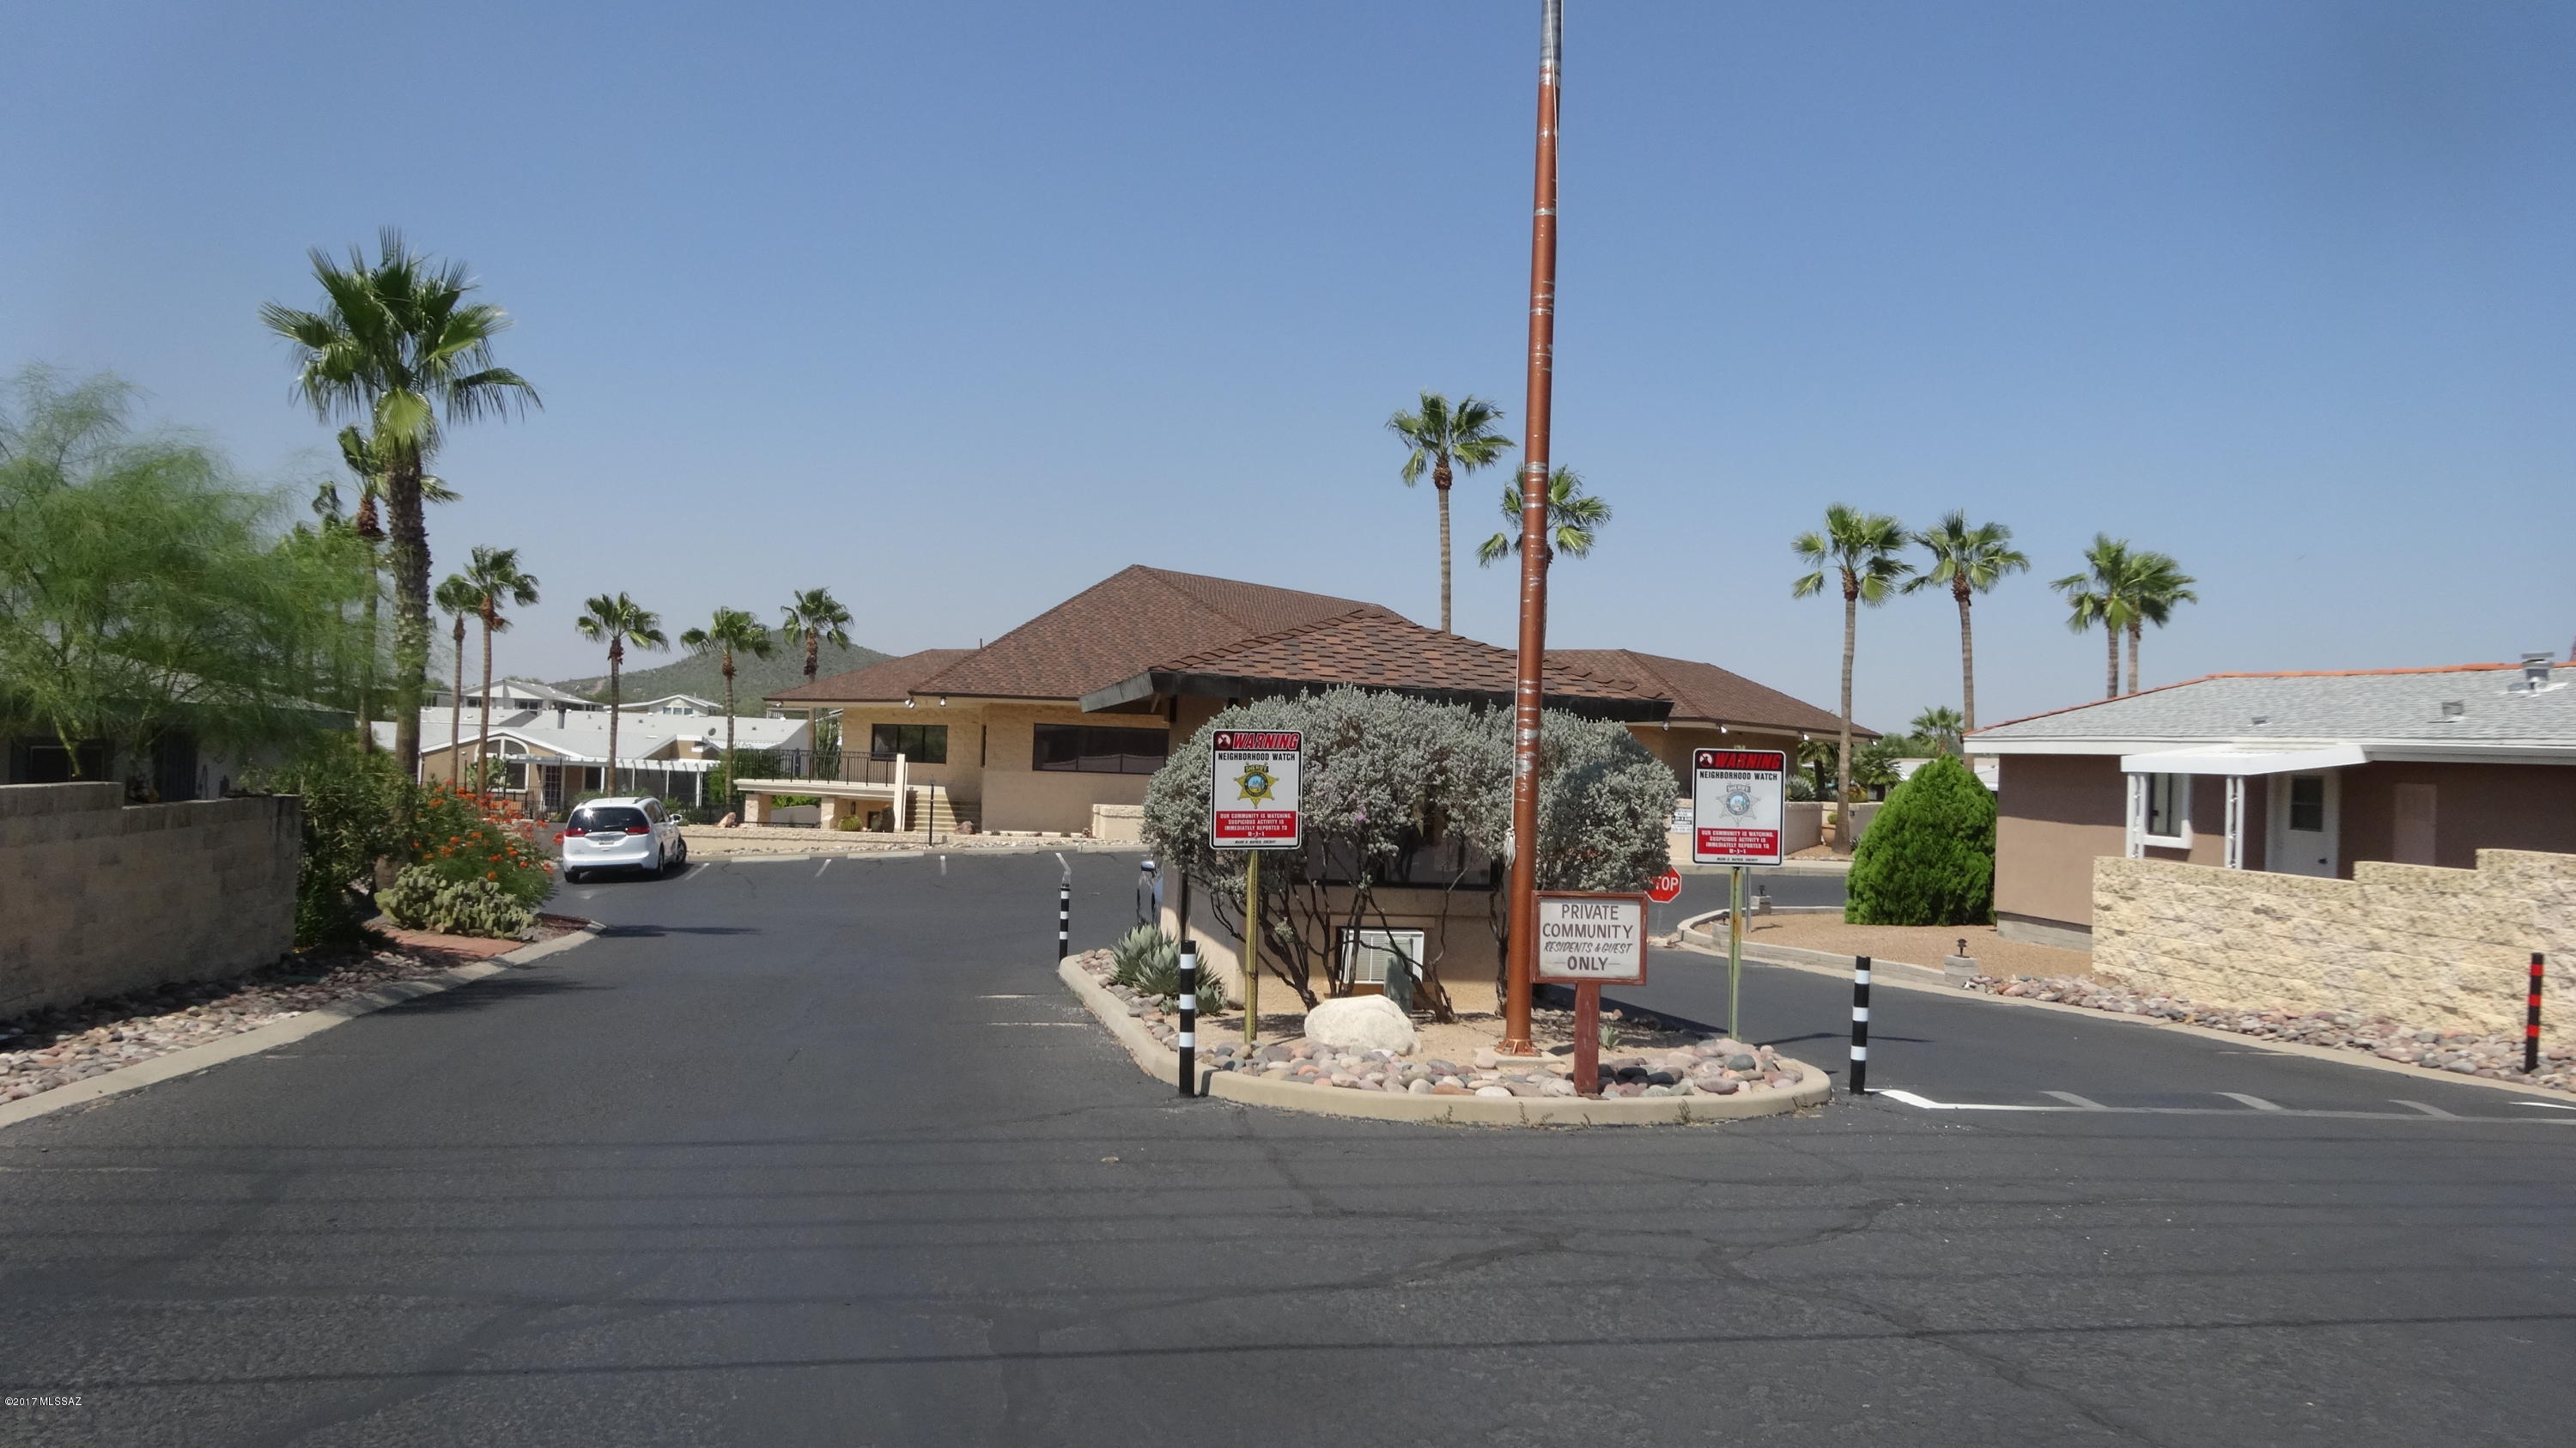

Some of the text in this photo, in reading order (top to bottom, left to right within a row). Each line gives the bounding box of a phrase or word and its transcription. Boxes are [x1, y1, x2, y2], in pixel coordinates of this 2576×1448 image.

[1232, 733, 1300, 750] WARNING
[1218, 752, 1296, 761] NEIGHBORHOOD WATCH
[1714, 752, 1782, 770] WARNING
[1699, 770, 1777, 781] NEIGHBORHOOD WATCH
[1561, 904, 1619, 921] PRIVATE
[1542, 922, 1633, 939] COMMUNITY
[1544, 941, 1633, 954] RESIDENTS & GUEST
[1567, 955, 1608, 970] ONLY
